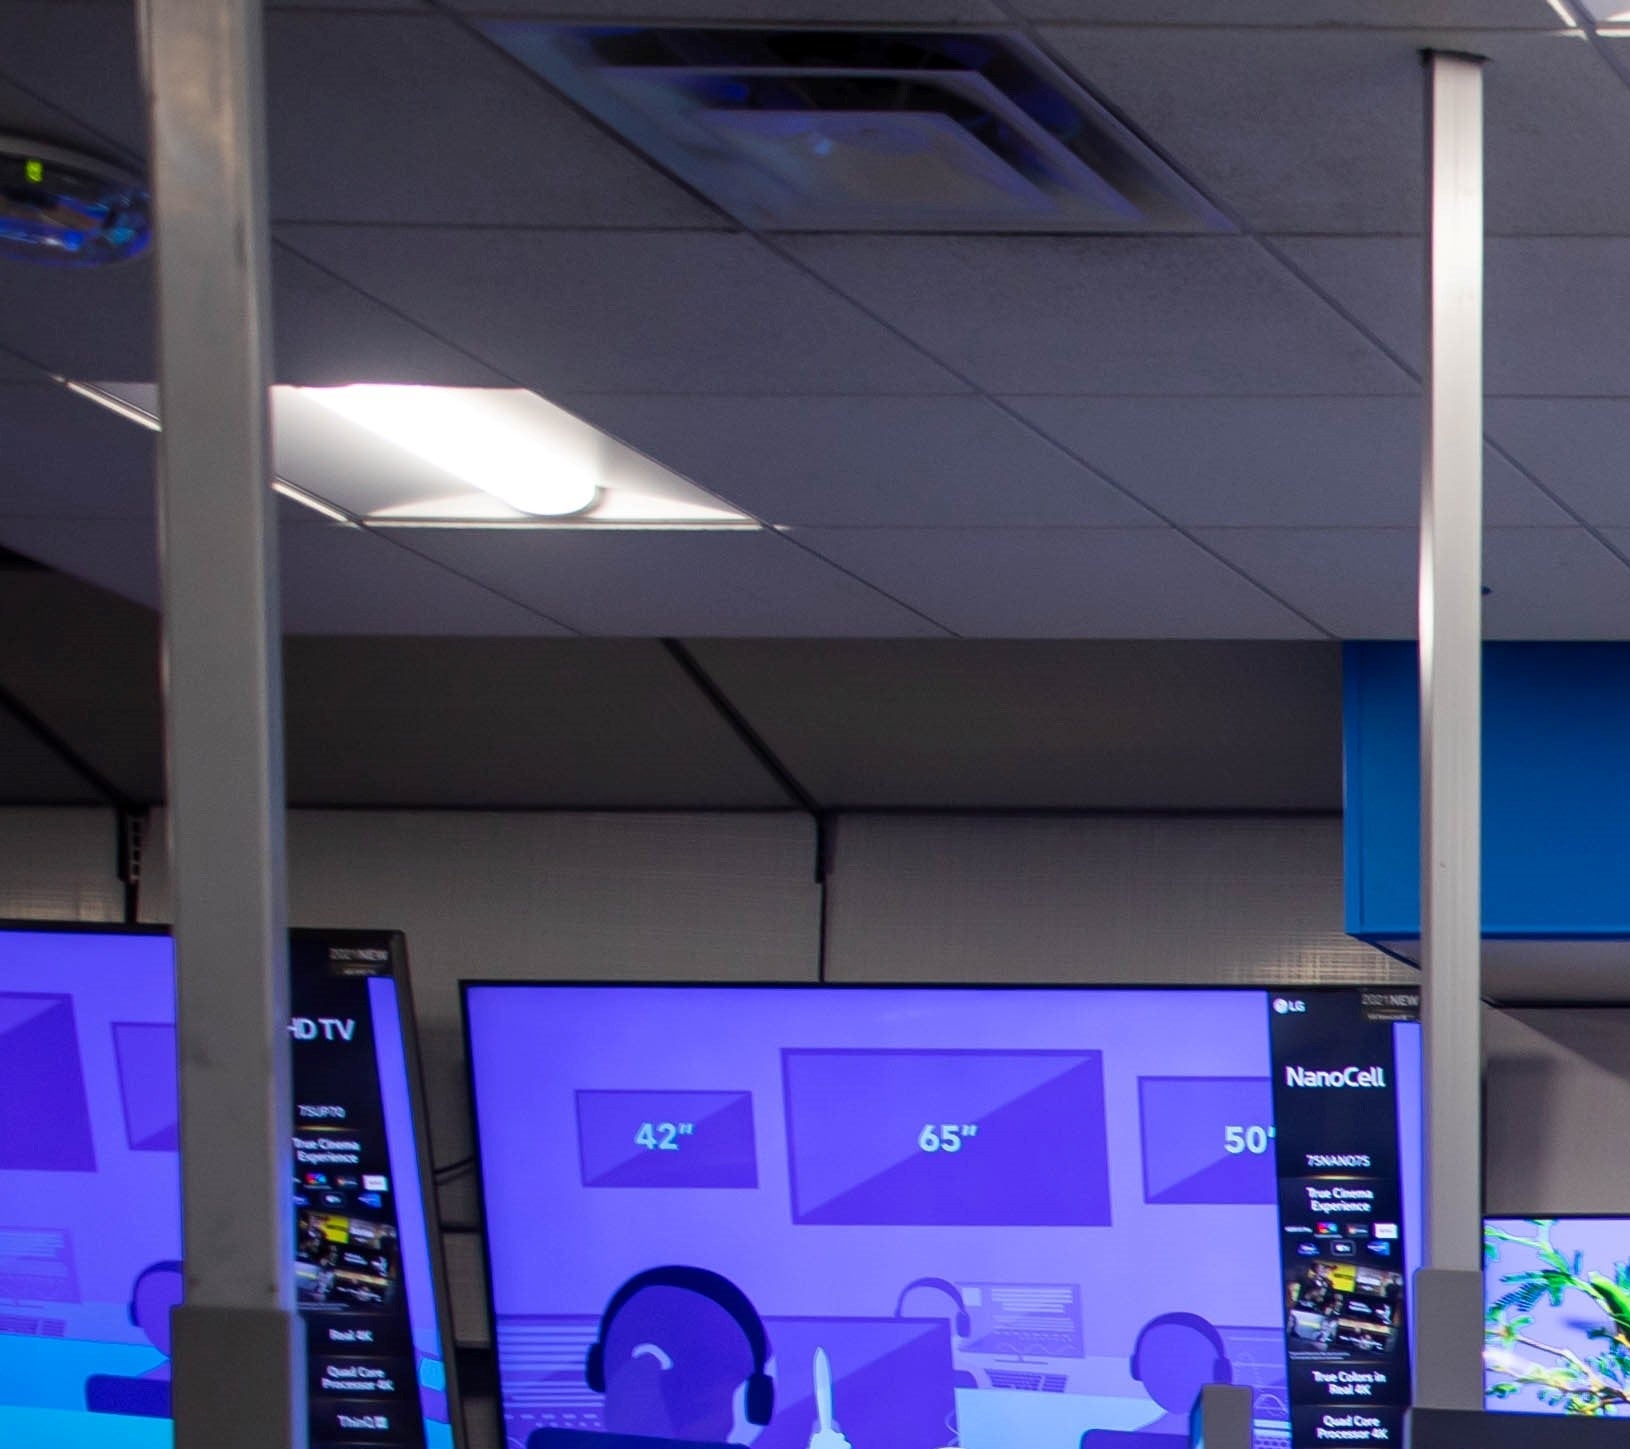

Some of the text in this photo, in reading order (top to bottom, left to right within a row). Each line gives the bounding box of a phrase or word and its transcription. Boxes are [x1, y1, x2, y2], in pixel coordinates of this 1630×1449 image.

[1288, 1000, 1306, 1012] LG
[318, 1018, 356, 1041] TV
[1286, 1066, 1387, 1088] NanoCell
[919, 1124, 978, 1152] 65"
[1306, 1187, 1375, 1199] True Cinema
[1310, 1199, 1372, 1214] Experience
[1312, 1371, 1338, 1382] True
[1329, 1384, 1372, 1395] Real 4K
